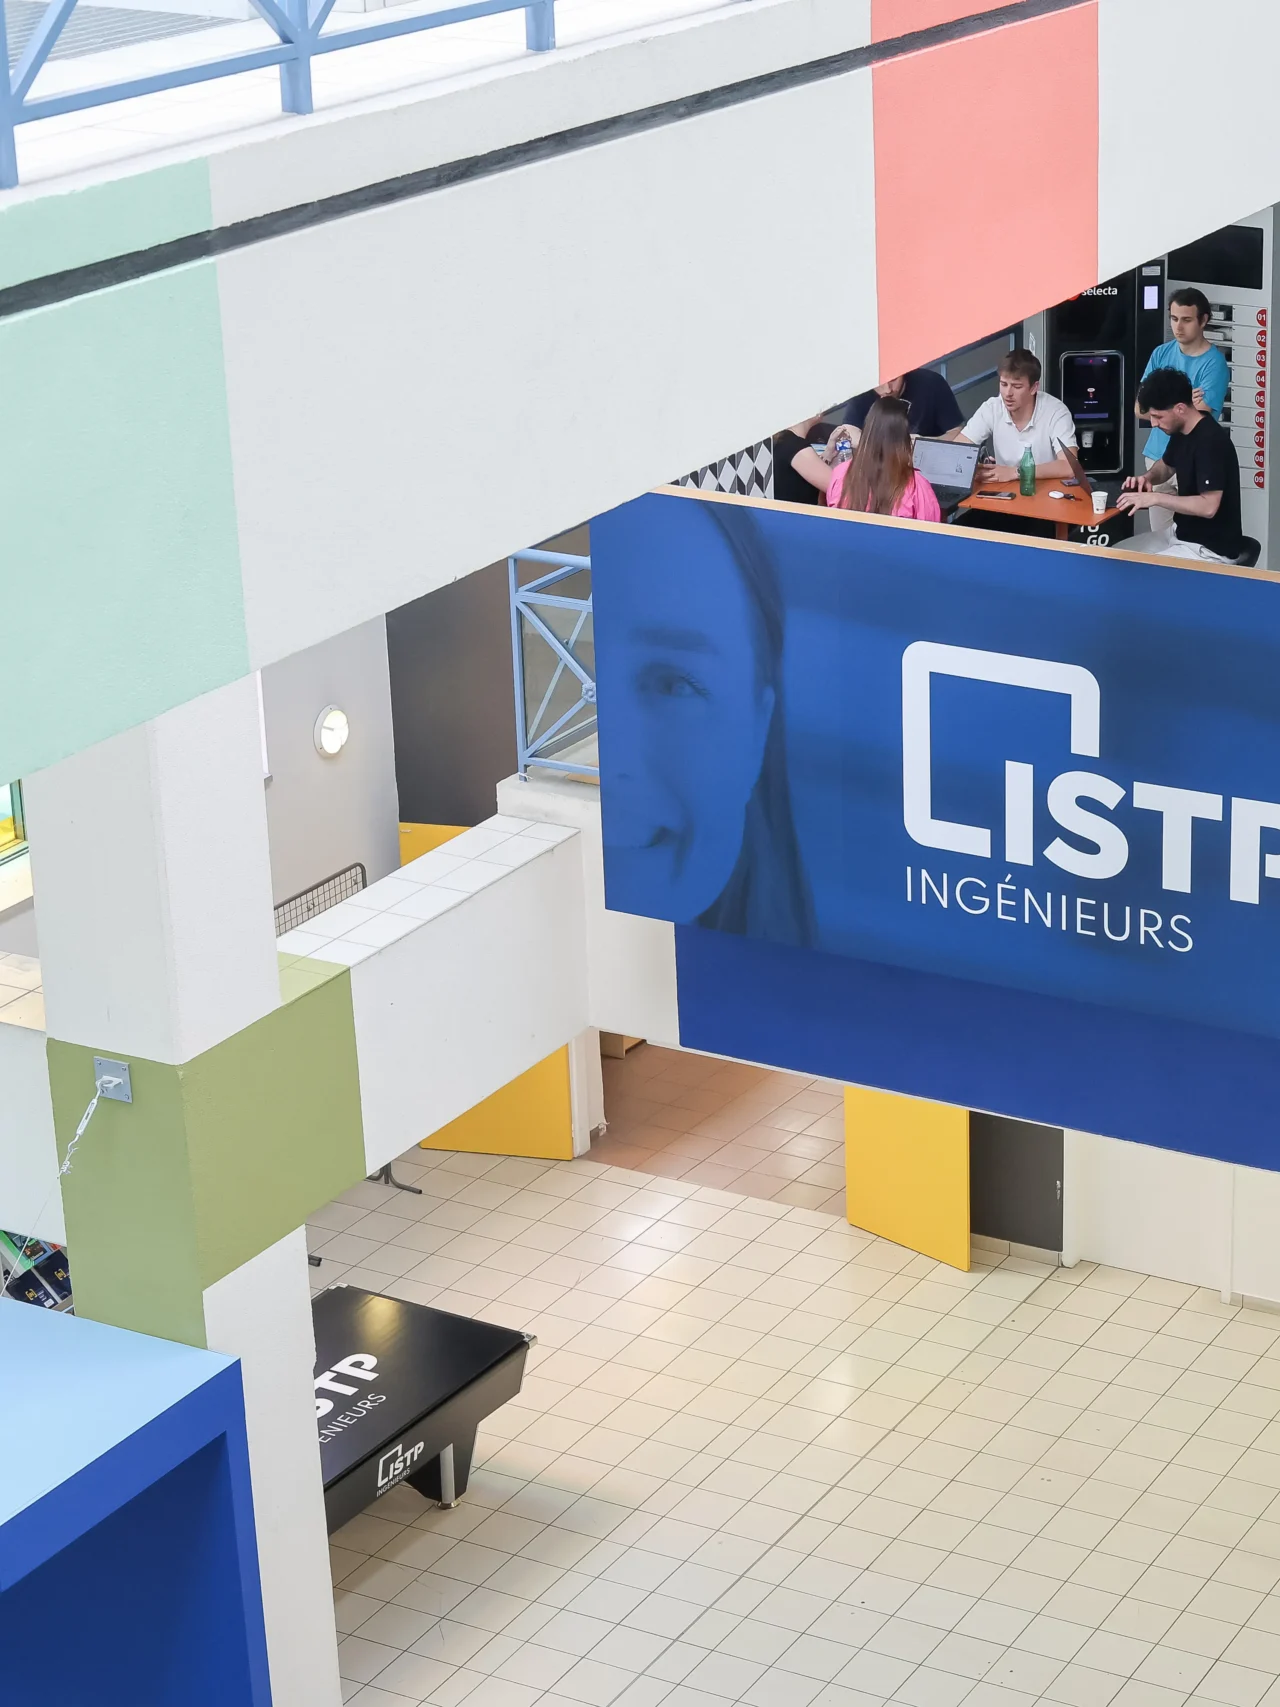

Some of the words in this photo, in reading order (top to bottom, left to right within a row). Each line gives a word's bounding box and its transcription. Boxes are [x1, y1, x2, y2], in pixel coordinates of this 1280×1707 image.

[1257, 313, 1266, 321] 01
[1256, 354, 1266, 362] 03
[1255, 395, 1265, 403] 05
[1255, 415, 1265, 423] 06
[1254, 475, 1264, 483] 09
[1086, 533, 1110, 547] GO
[906, 866, 1194, 953] INGÉNIEURS
[388, 1441, 425, 1480] ISTP
